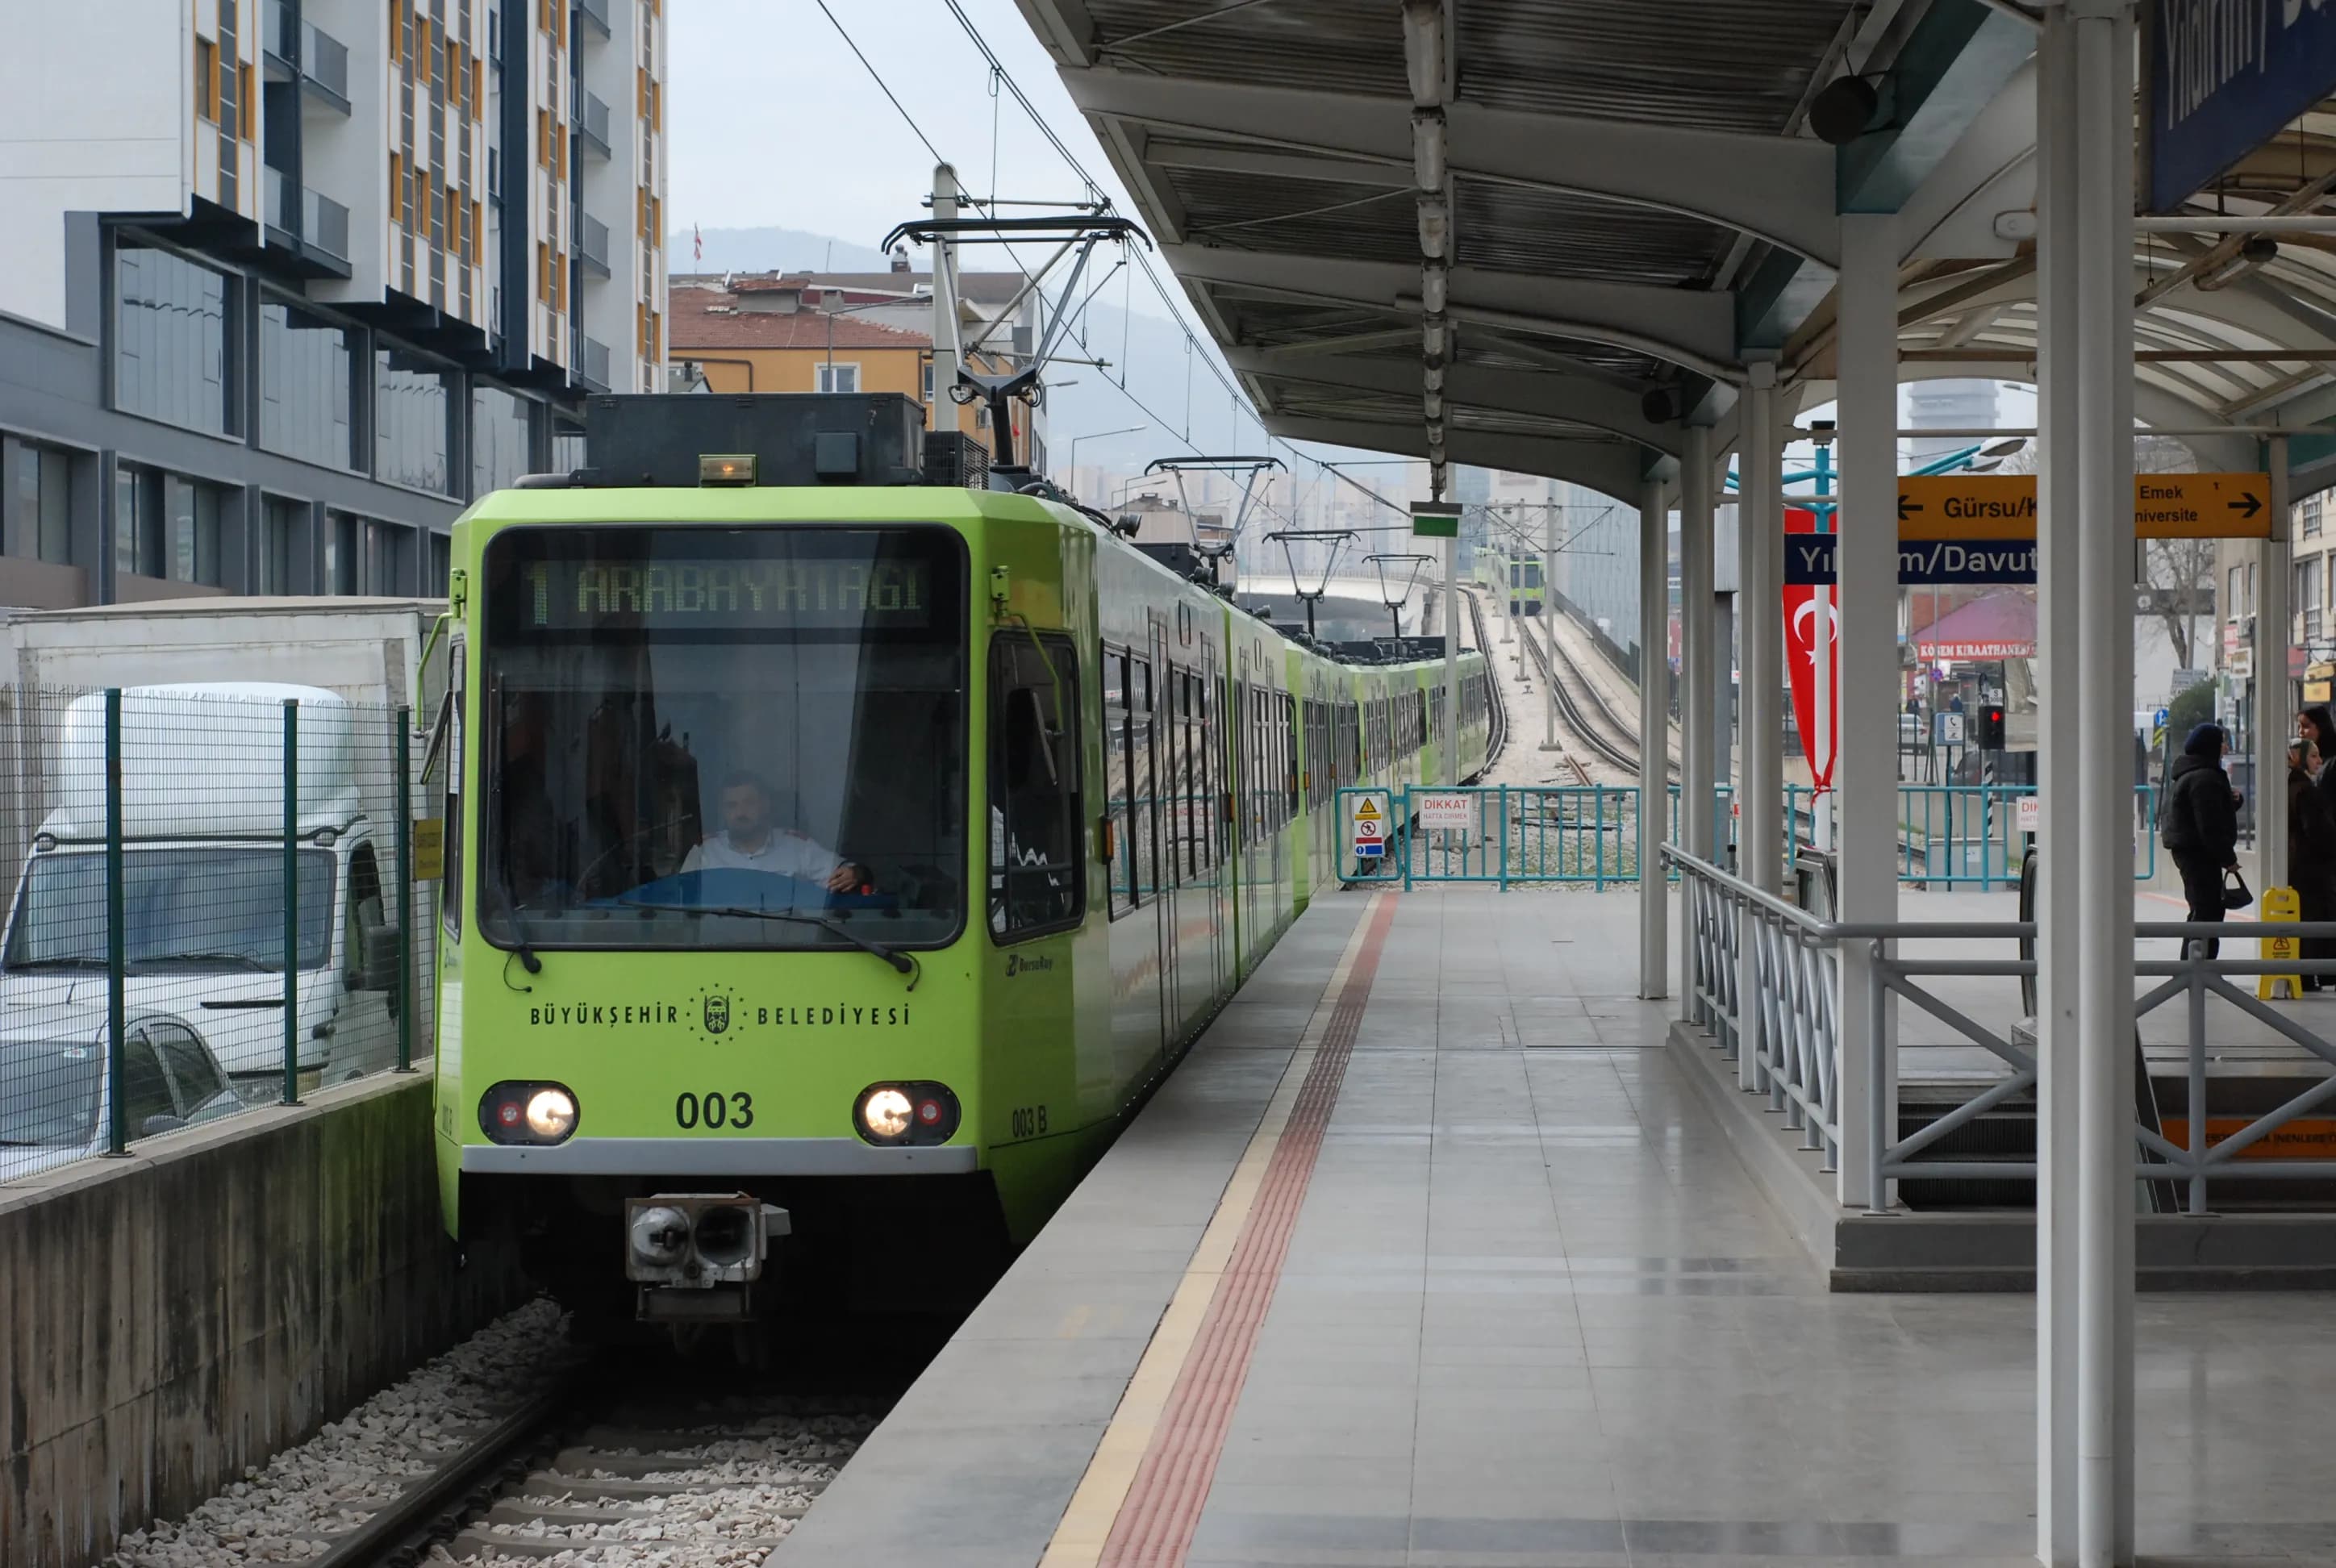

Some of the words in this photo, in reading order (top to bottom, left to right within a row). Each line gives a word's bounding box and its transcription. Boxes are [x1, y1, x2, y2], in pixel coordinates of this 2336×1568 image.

[2140, 486, 2184, 499] Emek
[2134, 508, 2198, 523] niversite
[1425, 797, 1467, 810] DİKKAT
[530, 1000, 678, 1028] BÜYÜKŞEHİR
[757, 1002, 909, 1025] BELEDİYESİ
[676, 1091, 754, 1130] 003
[1012, 1108, 1034, 1138] 003
[1037, 1105, 1047, 1133] B
